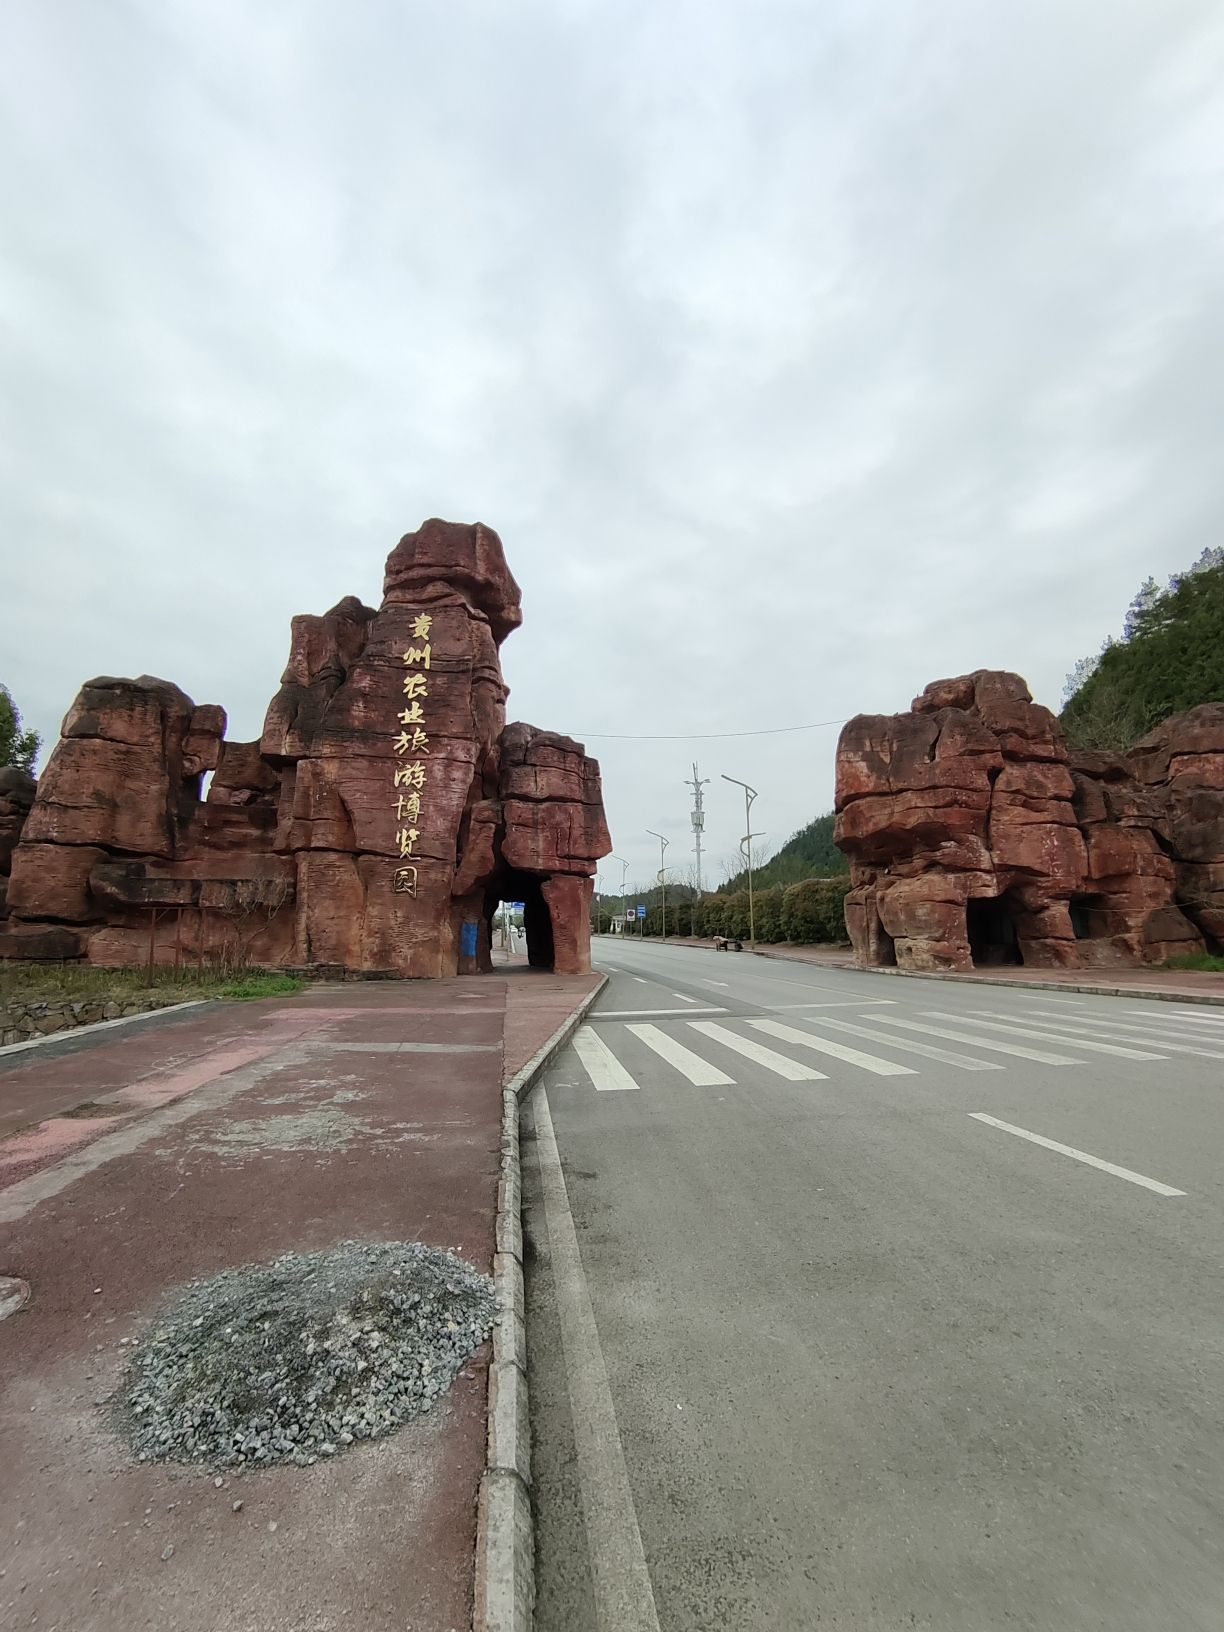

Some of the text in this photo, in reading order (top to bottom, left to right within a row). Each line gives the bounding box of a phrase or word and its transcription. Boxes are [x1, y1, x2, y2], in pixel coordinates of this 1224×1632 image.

[391, 612, 432, 898] 贵州农业旅游博览园
